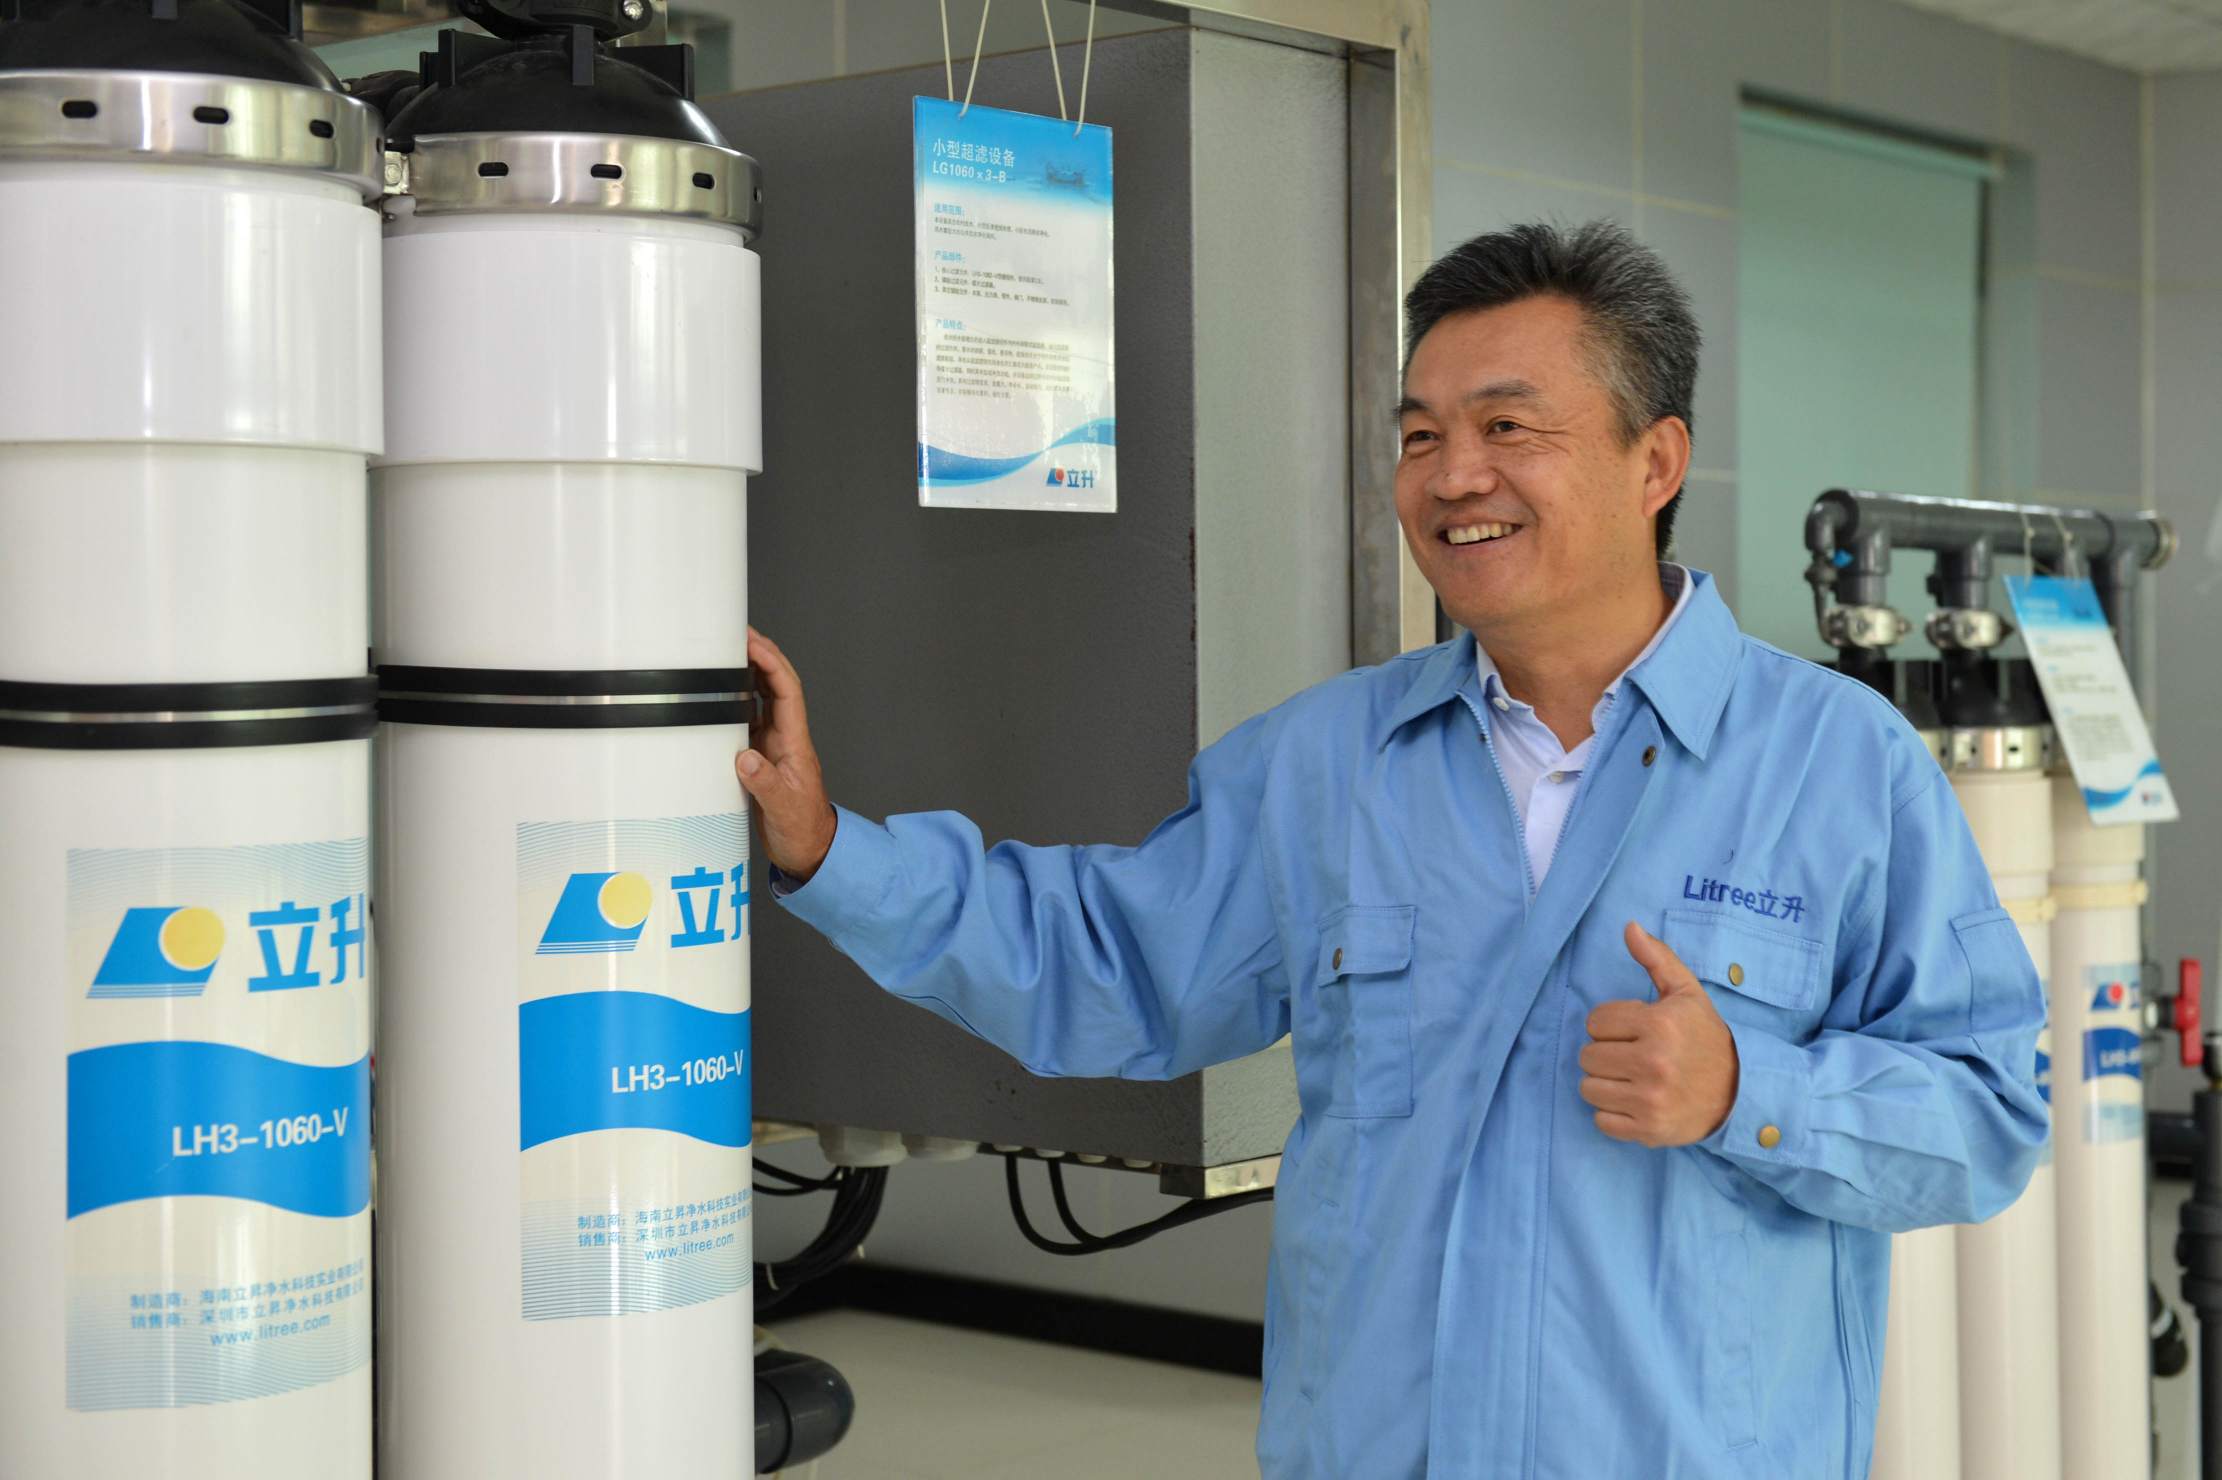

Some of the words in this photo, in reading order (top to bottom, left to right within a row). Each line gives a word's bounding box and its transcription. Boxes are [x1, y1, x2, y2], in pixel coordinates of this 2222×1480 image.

[932, 138, 1016, 168] 小型超滤设备
[1066, 468, 1095, 488] 立升
[670, 858, 750, 949] 立升
[1683, 874, 1806, 923] Litree立升
[247, 892, 366, 993] 立升
[612, 1049, 744, 1094] LH3-1060-V
[172, 1106, 349, 1157] LH3-1060-V
[645, 1232, 735, 1261] www.litree.com
[210, 1314, 331, 1346] www.litree.com
